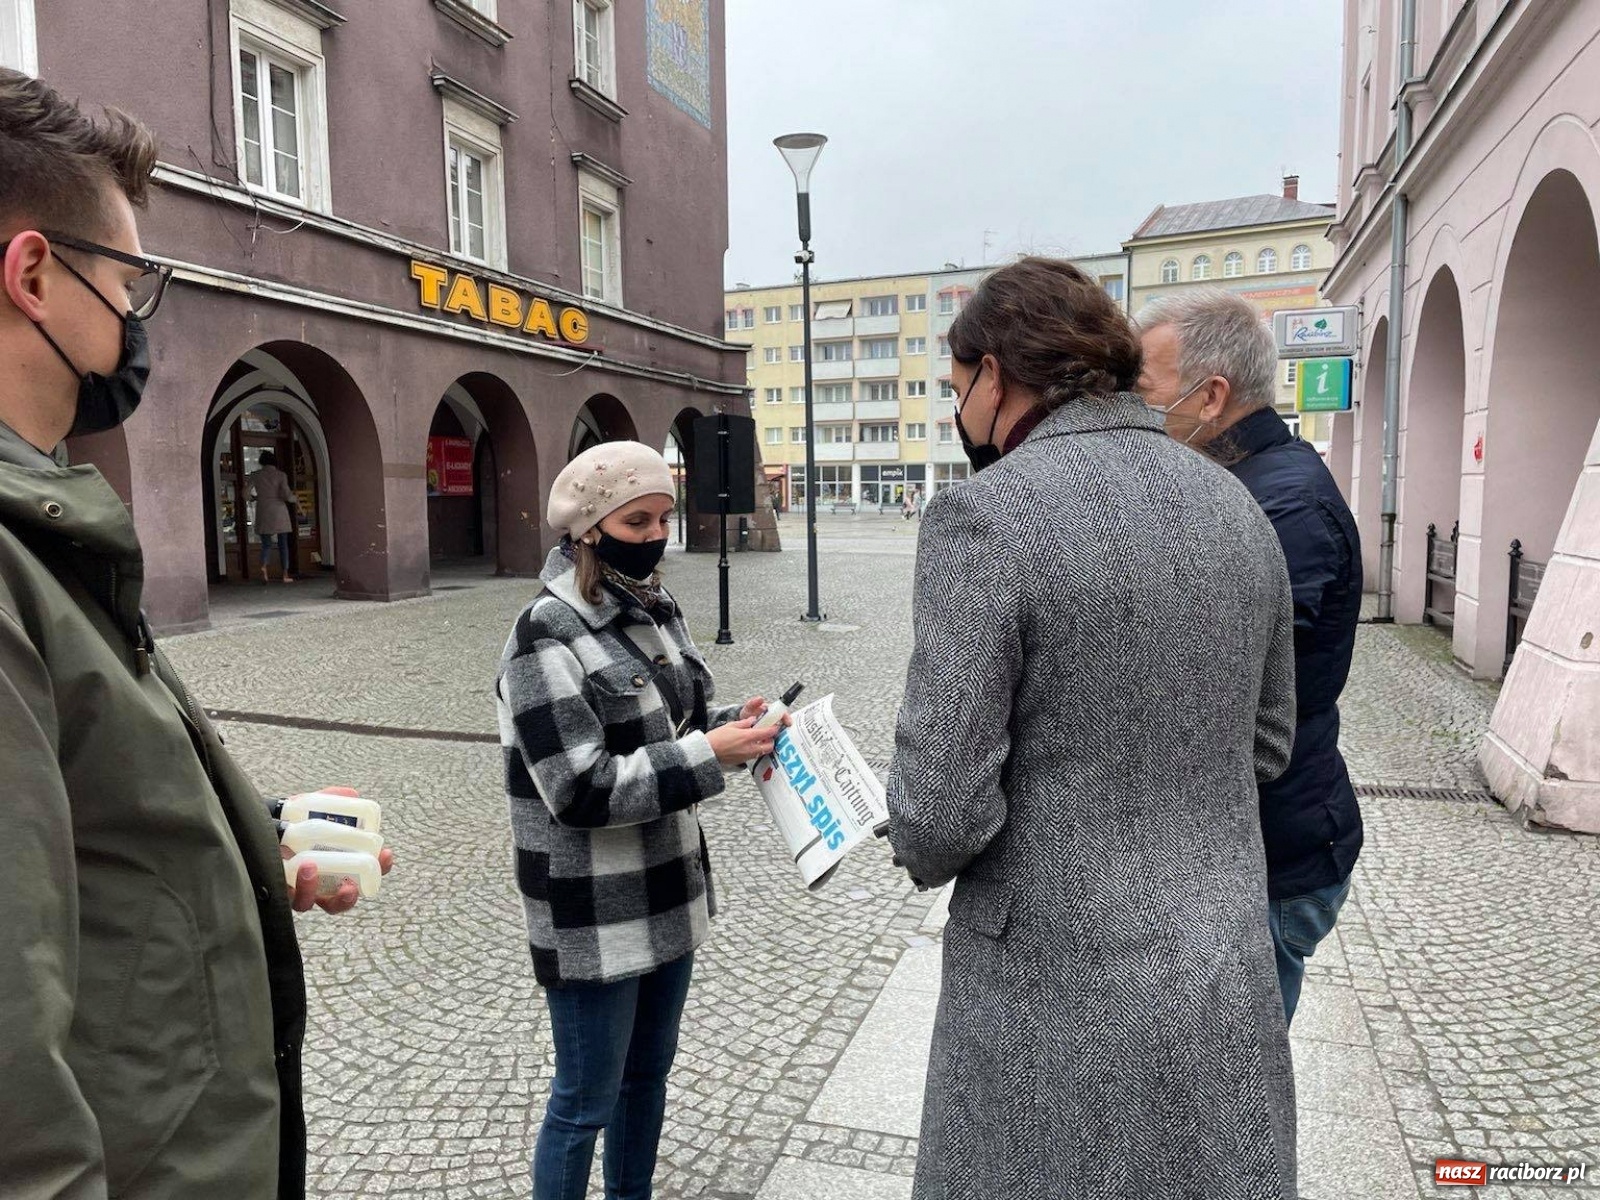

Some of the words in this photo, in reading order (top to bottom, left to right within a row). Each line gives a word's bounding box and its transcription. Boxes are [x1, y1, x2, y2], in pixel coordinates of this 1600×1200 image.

[411, 260, 589, 345] TABAC
[775, 729, 816, 795] uszył
[807, 795, 845, 850] spis
